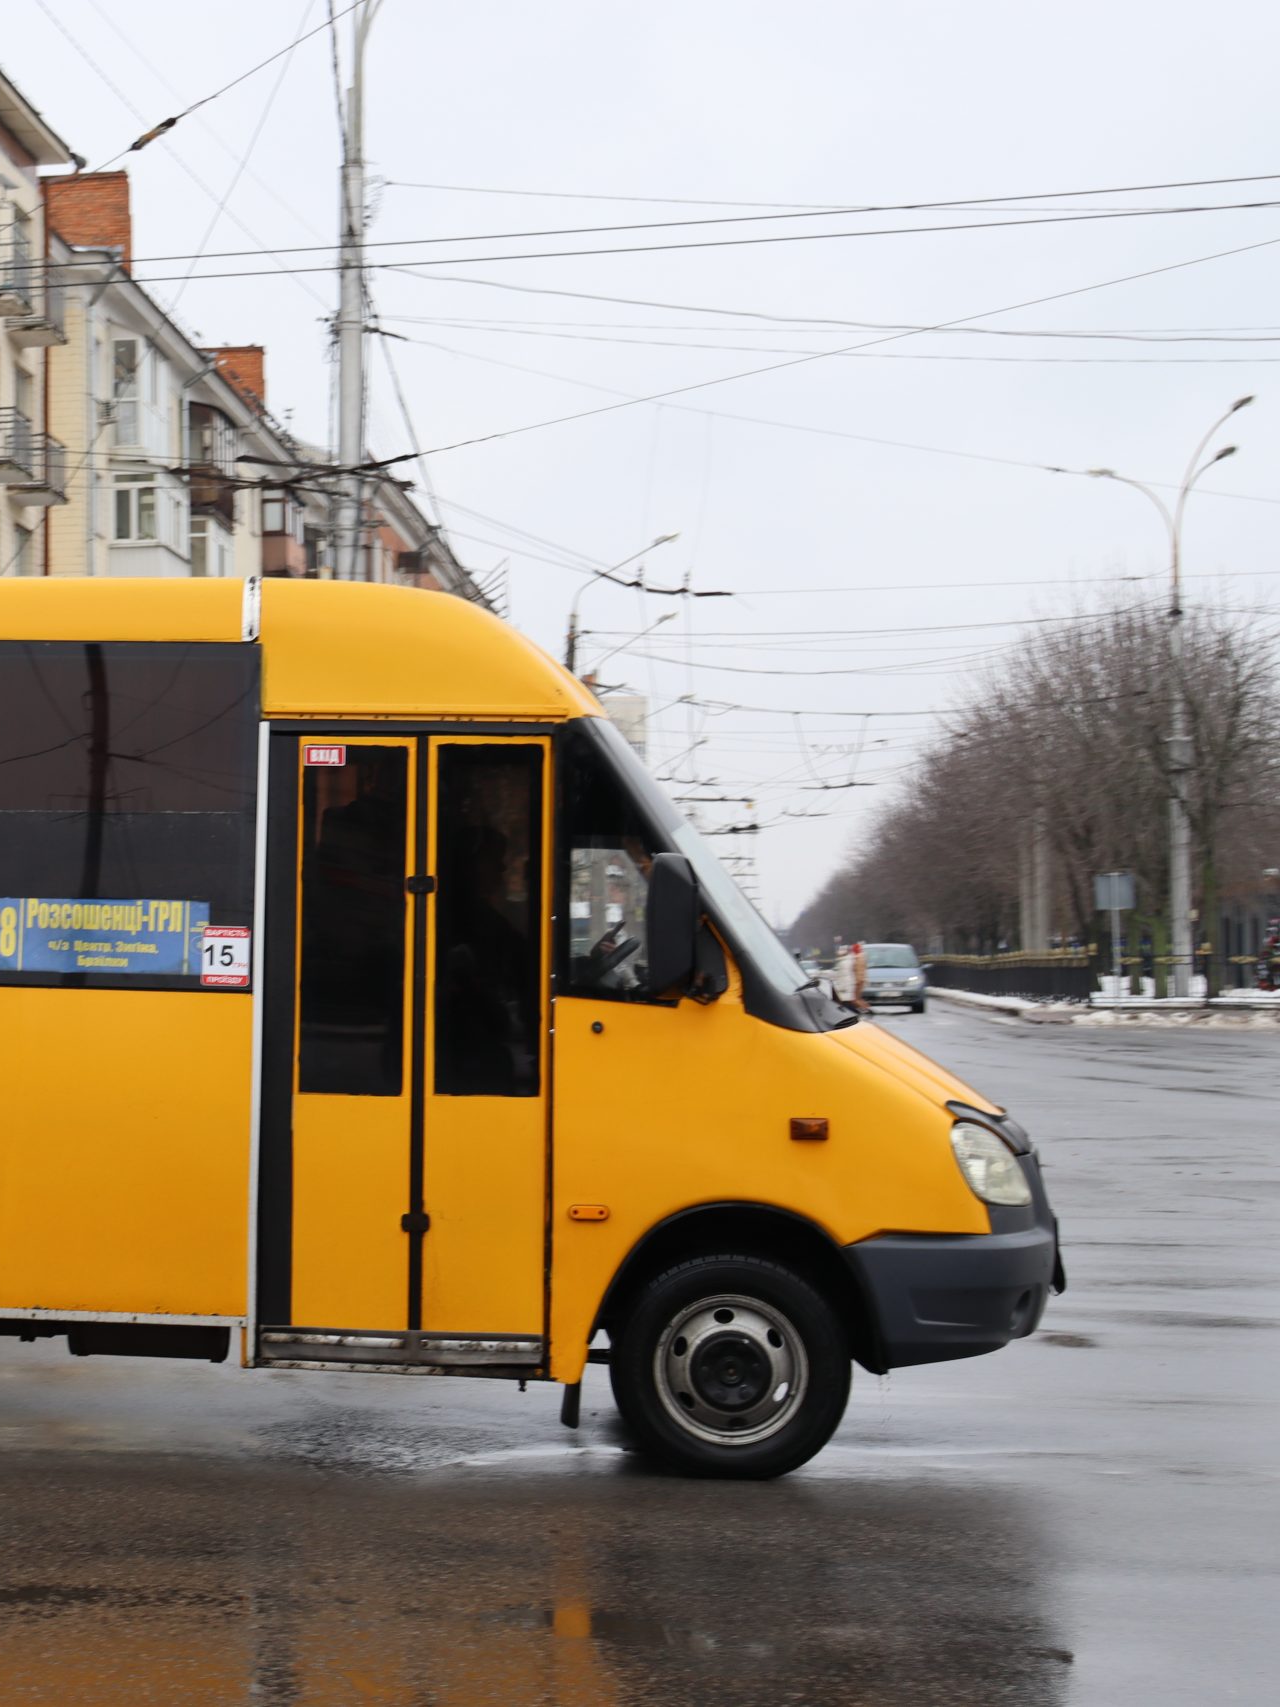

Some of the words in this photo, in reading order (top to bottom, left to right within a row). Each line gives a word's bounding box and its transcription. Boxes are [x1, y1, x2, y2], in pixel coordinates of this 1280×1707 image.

[26, 898, 183, 936] Розсошенці-ГРЛ
[204, 929, 249, 937] ВАРТІСТЬ
[204, 944, 234, 967] 15
